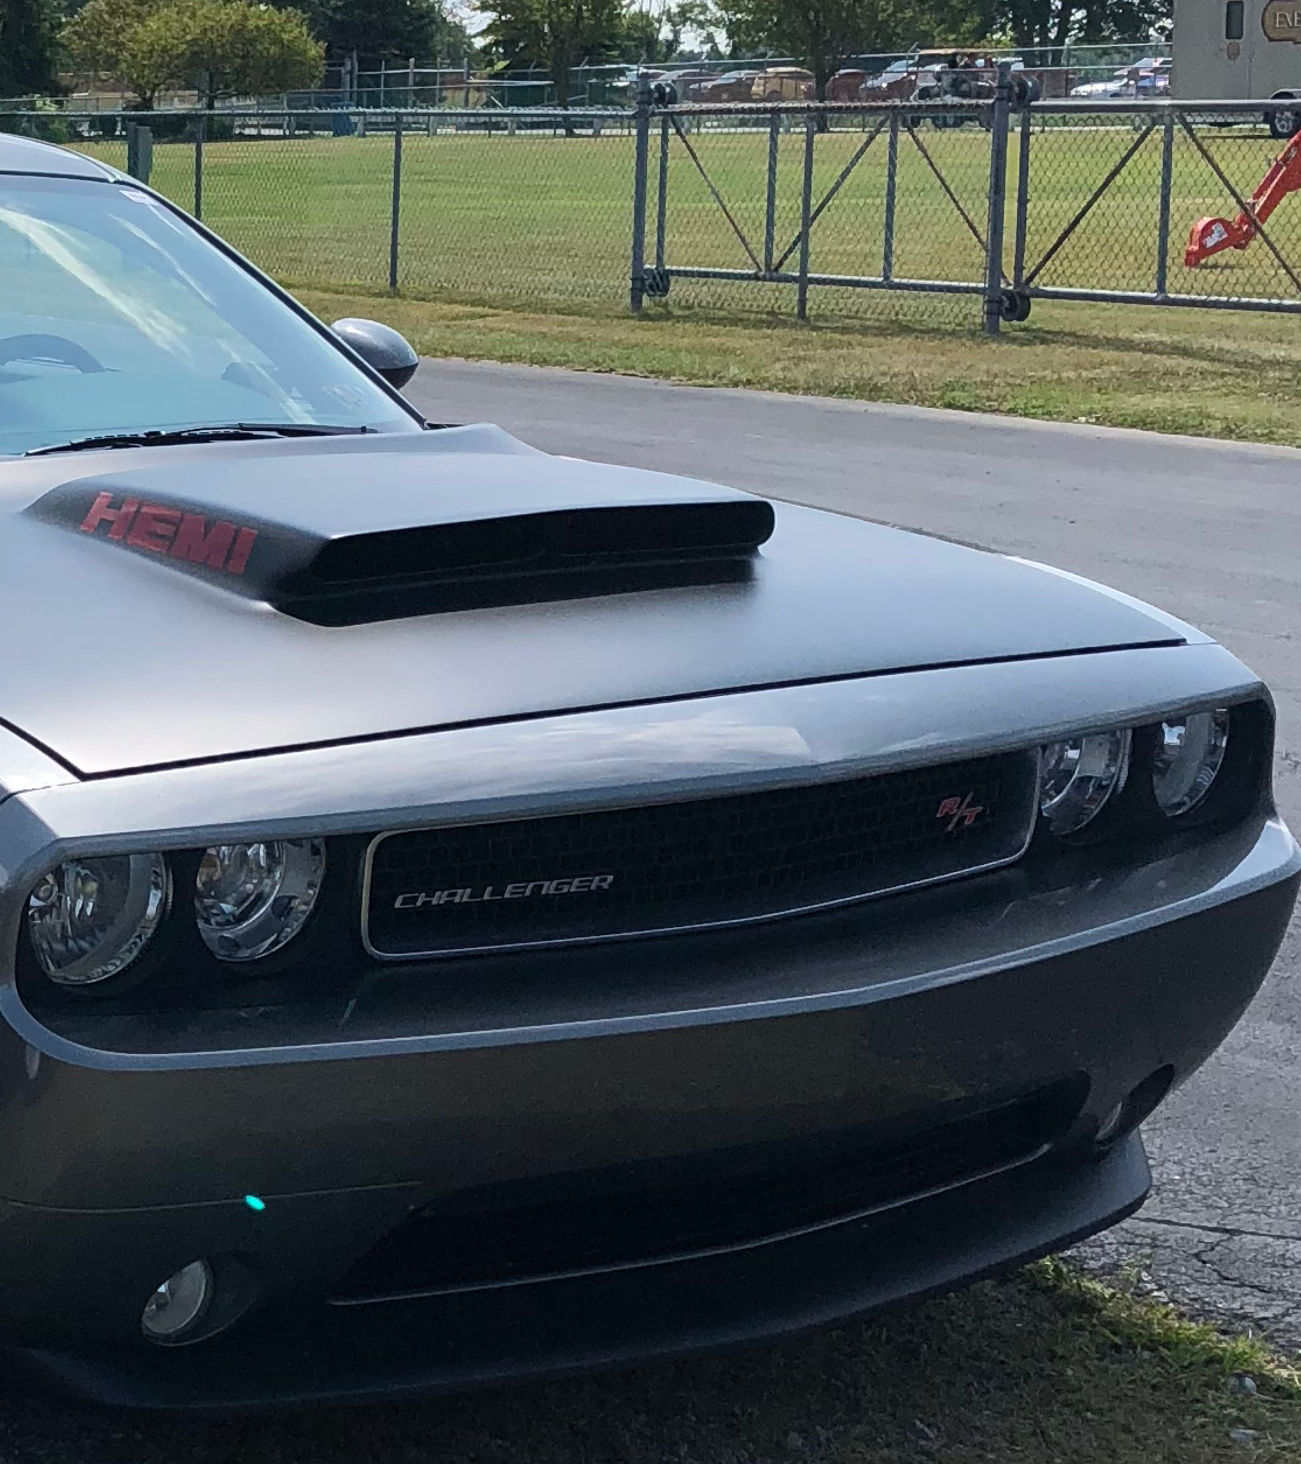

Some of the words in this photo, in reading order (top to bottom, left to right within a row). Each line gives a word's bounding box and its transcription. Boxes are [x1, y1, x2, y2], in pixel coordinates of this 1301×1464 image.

[80, 491, 258, 575] HEMI
[935, 791, 983, 832] R/T
[394, 874, 614, 909] CHALLENGER
